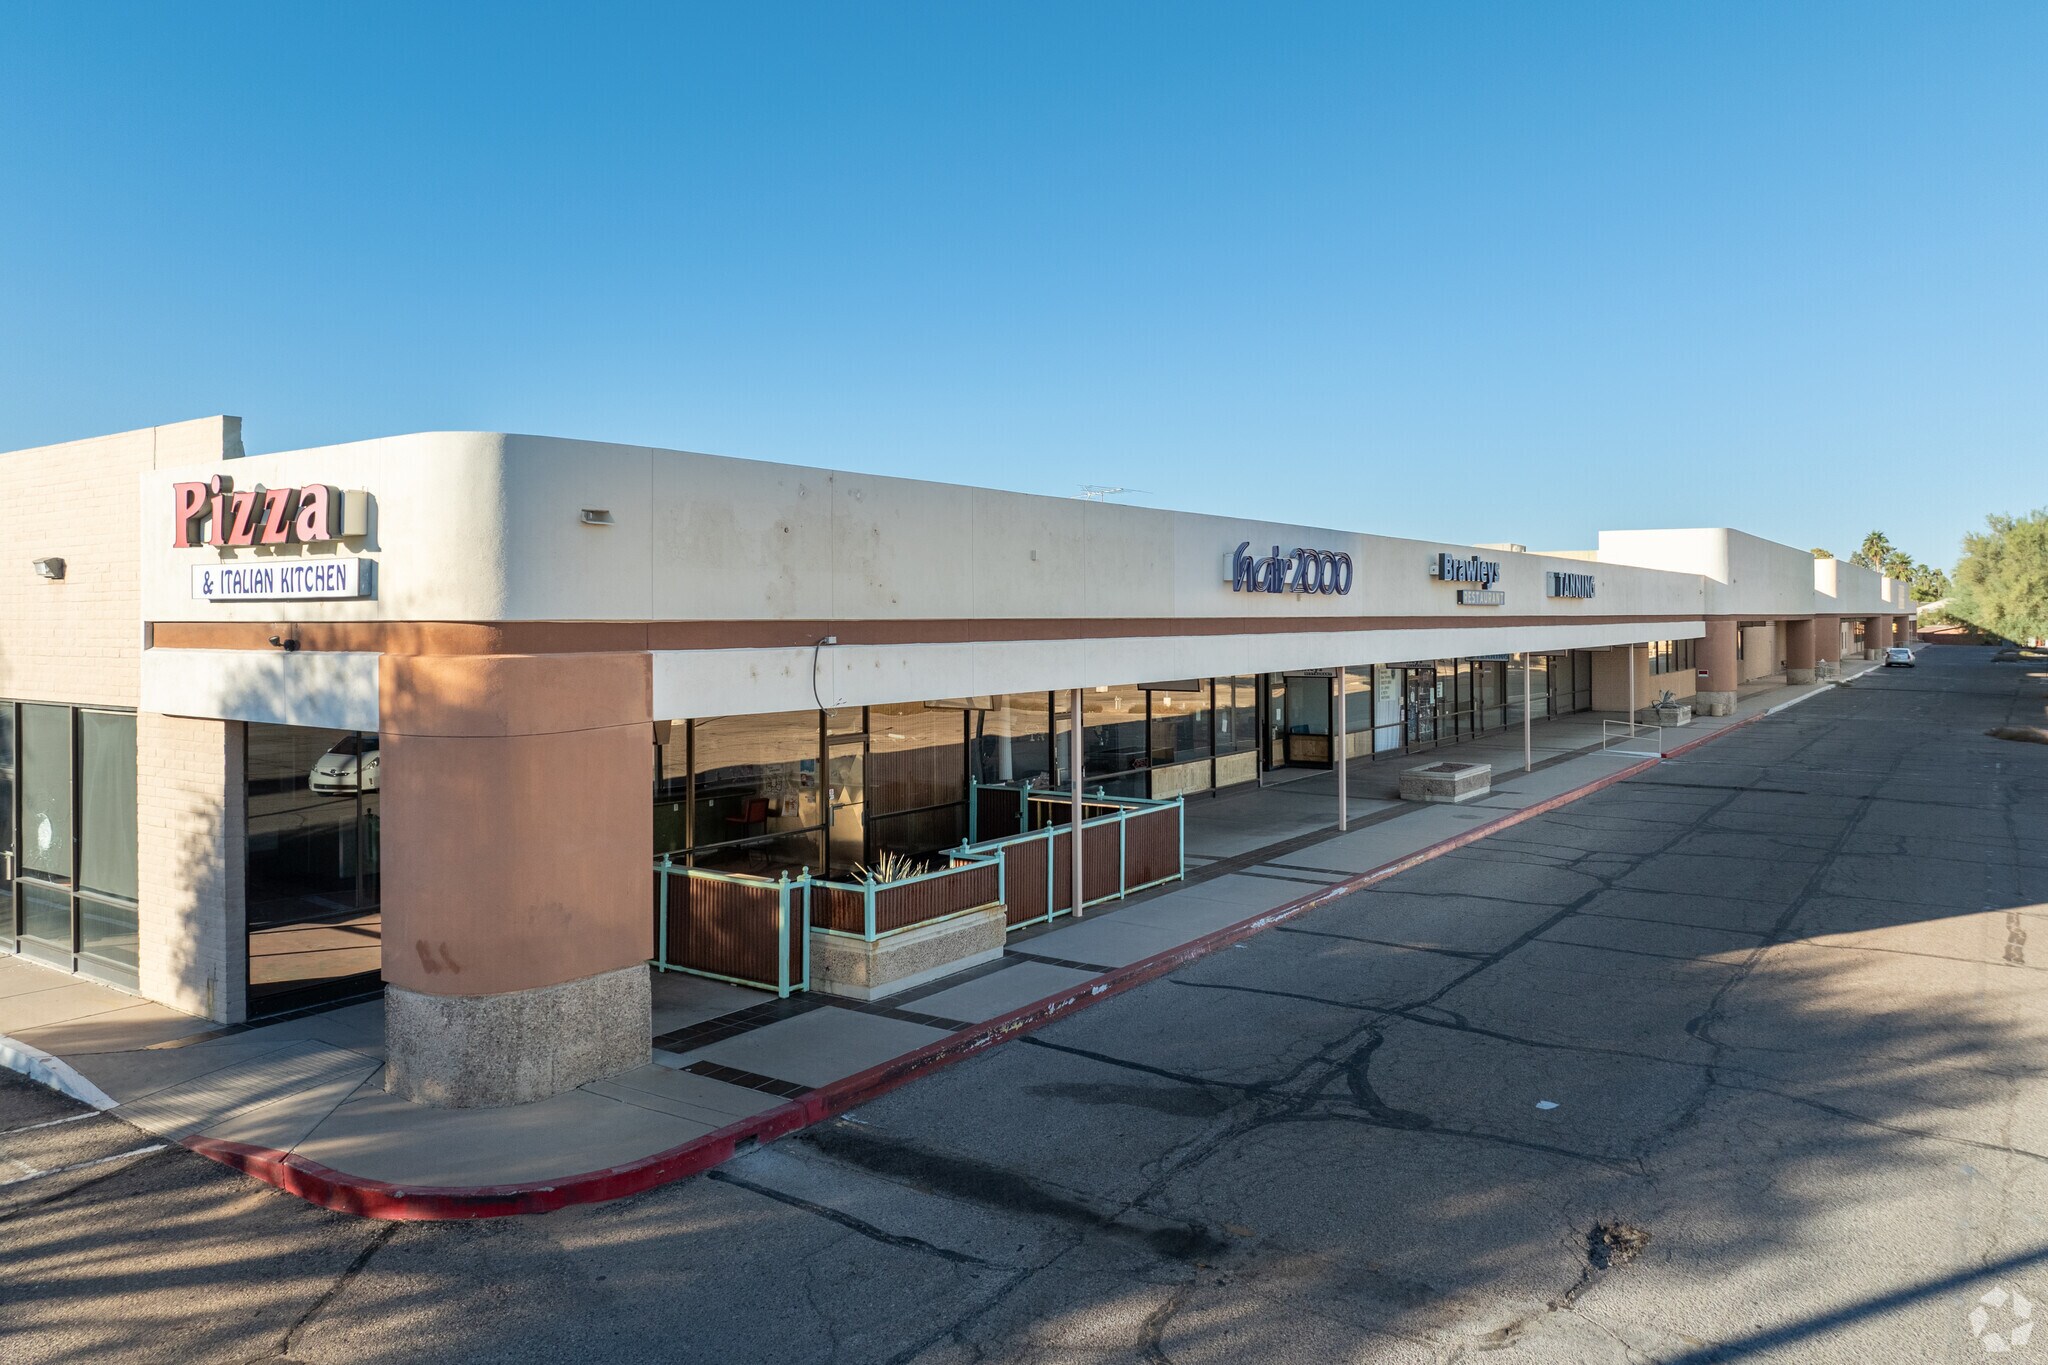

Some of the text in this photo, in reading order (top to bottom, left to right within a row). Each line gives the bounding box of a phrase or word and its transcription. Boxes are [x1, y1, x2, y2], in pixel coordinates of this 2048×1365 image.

[173, 474, 333, 548] Pizza
[202, 564, 346, 595] & ITALIAN KITCHEN
[1441, 553, 1500, 590] Brawleys
[1557, 572, 1596, 598] TANNING
[1463, 591, 1504, 605] RESTAURANT
